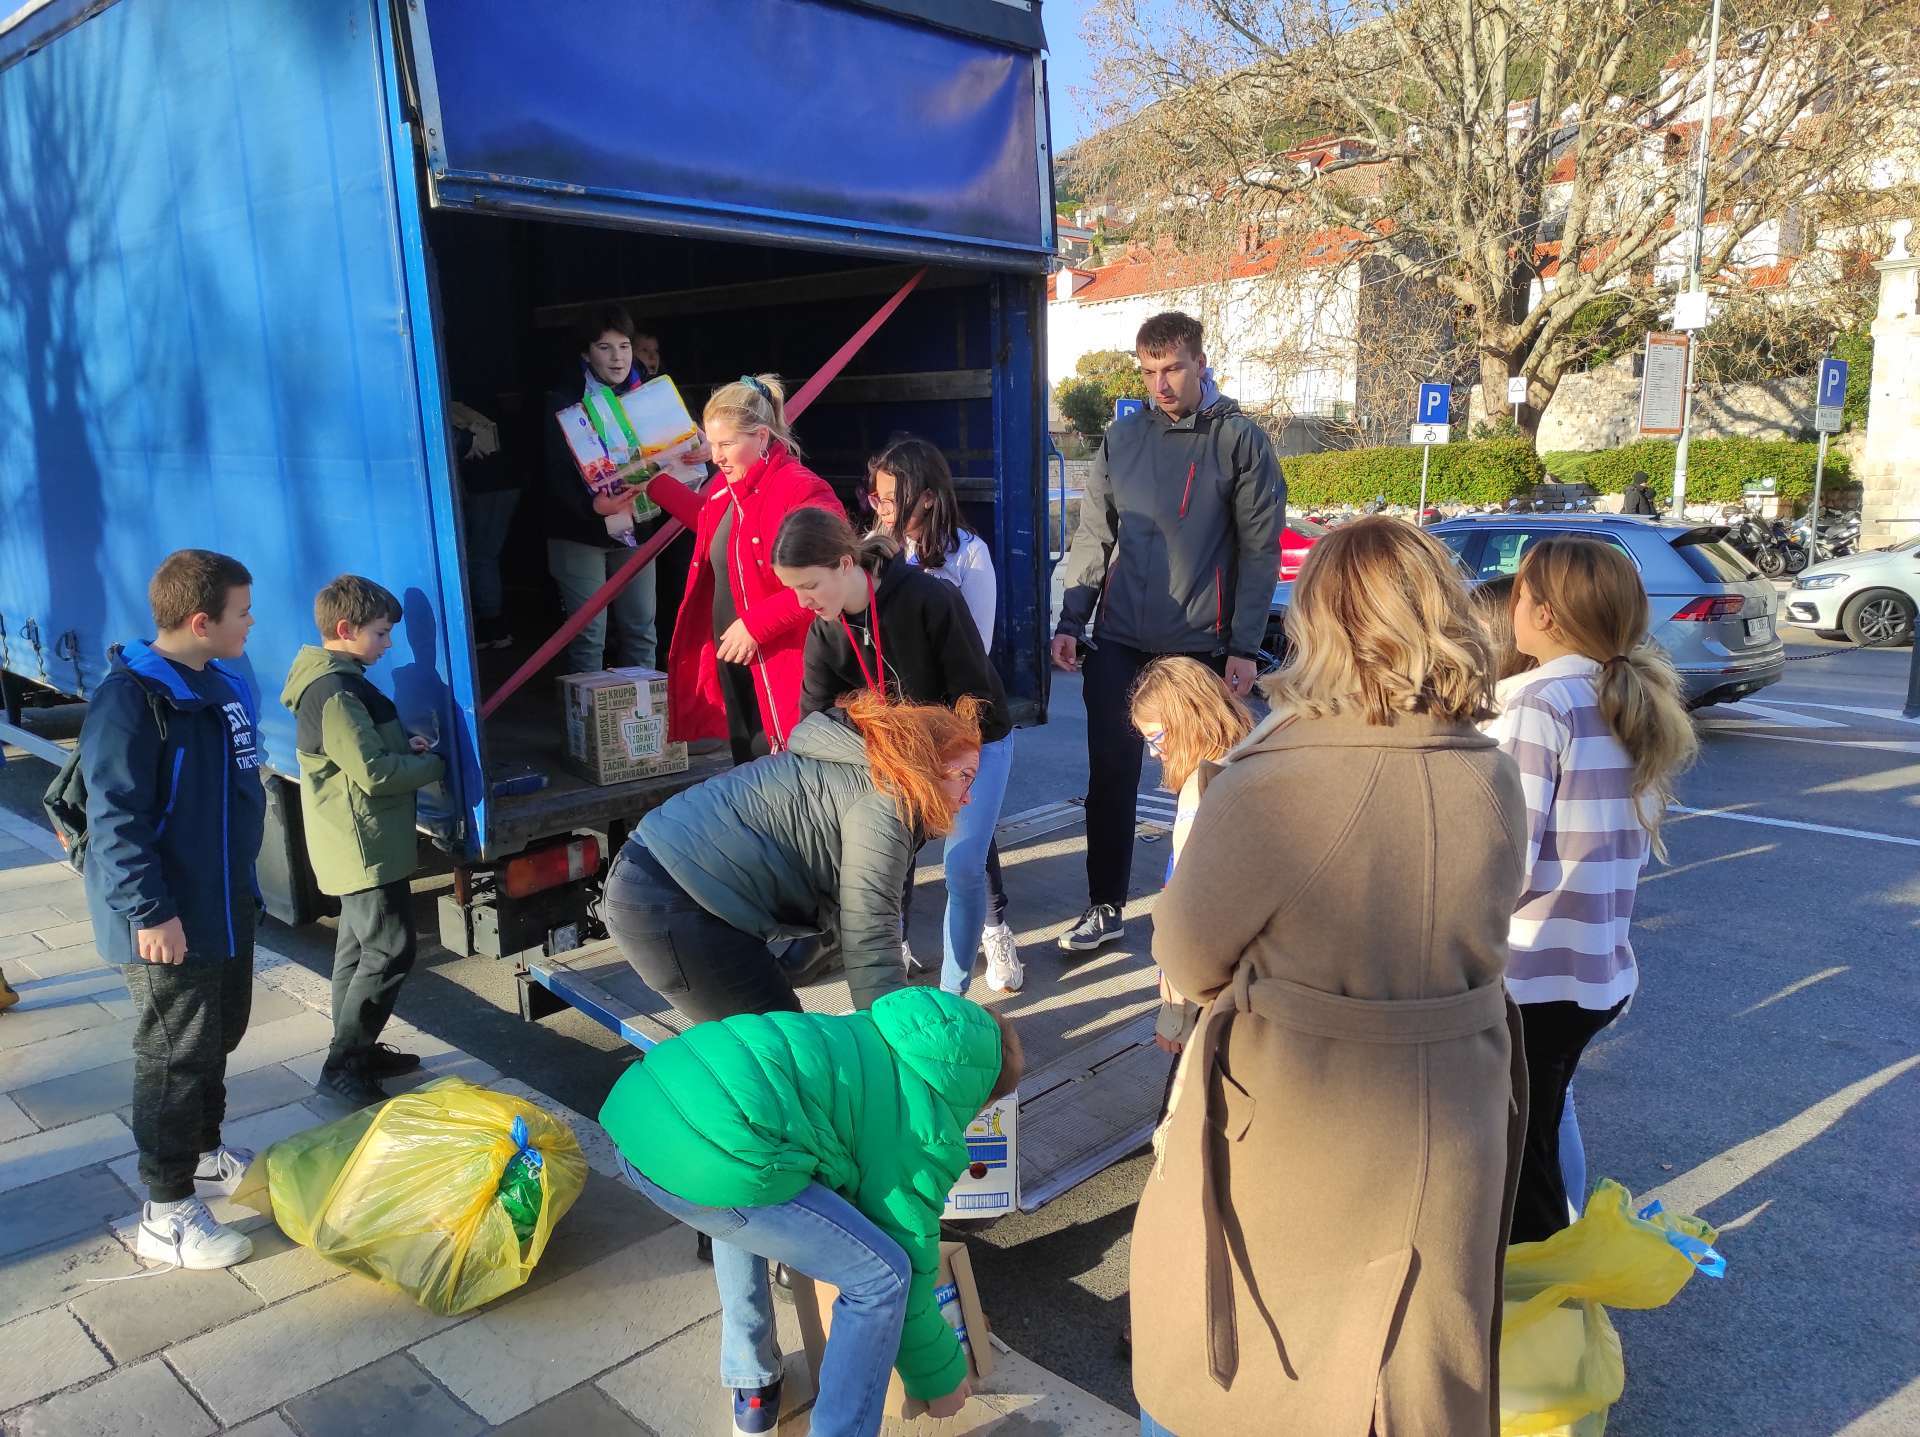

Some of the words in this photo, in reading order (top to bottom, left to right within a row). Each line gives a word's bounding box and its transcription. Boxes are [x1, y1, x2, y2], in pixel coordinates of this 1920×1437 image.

[1827, 369, 1840, 397] P
[1427, 391, 1441, 416] P
[599, 713, 610, 746] MORSKE
[628, 722, 658, 734] TVORNICA
[632, 733, 655, 744] ZDRAVE
[634, 743, 655, 753] HRANE
[603, 767, 650, 782] SUPERHRANA
